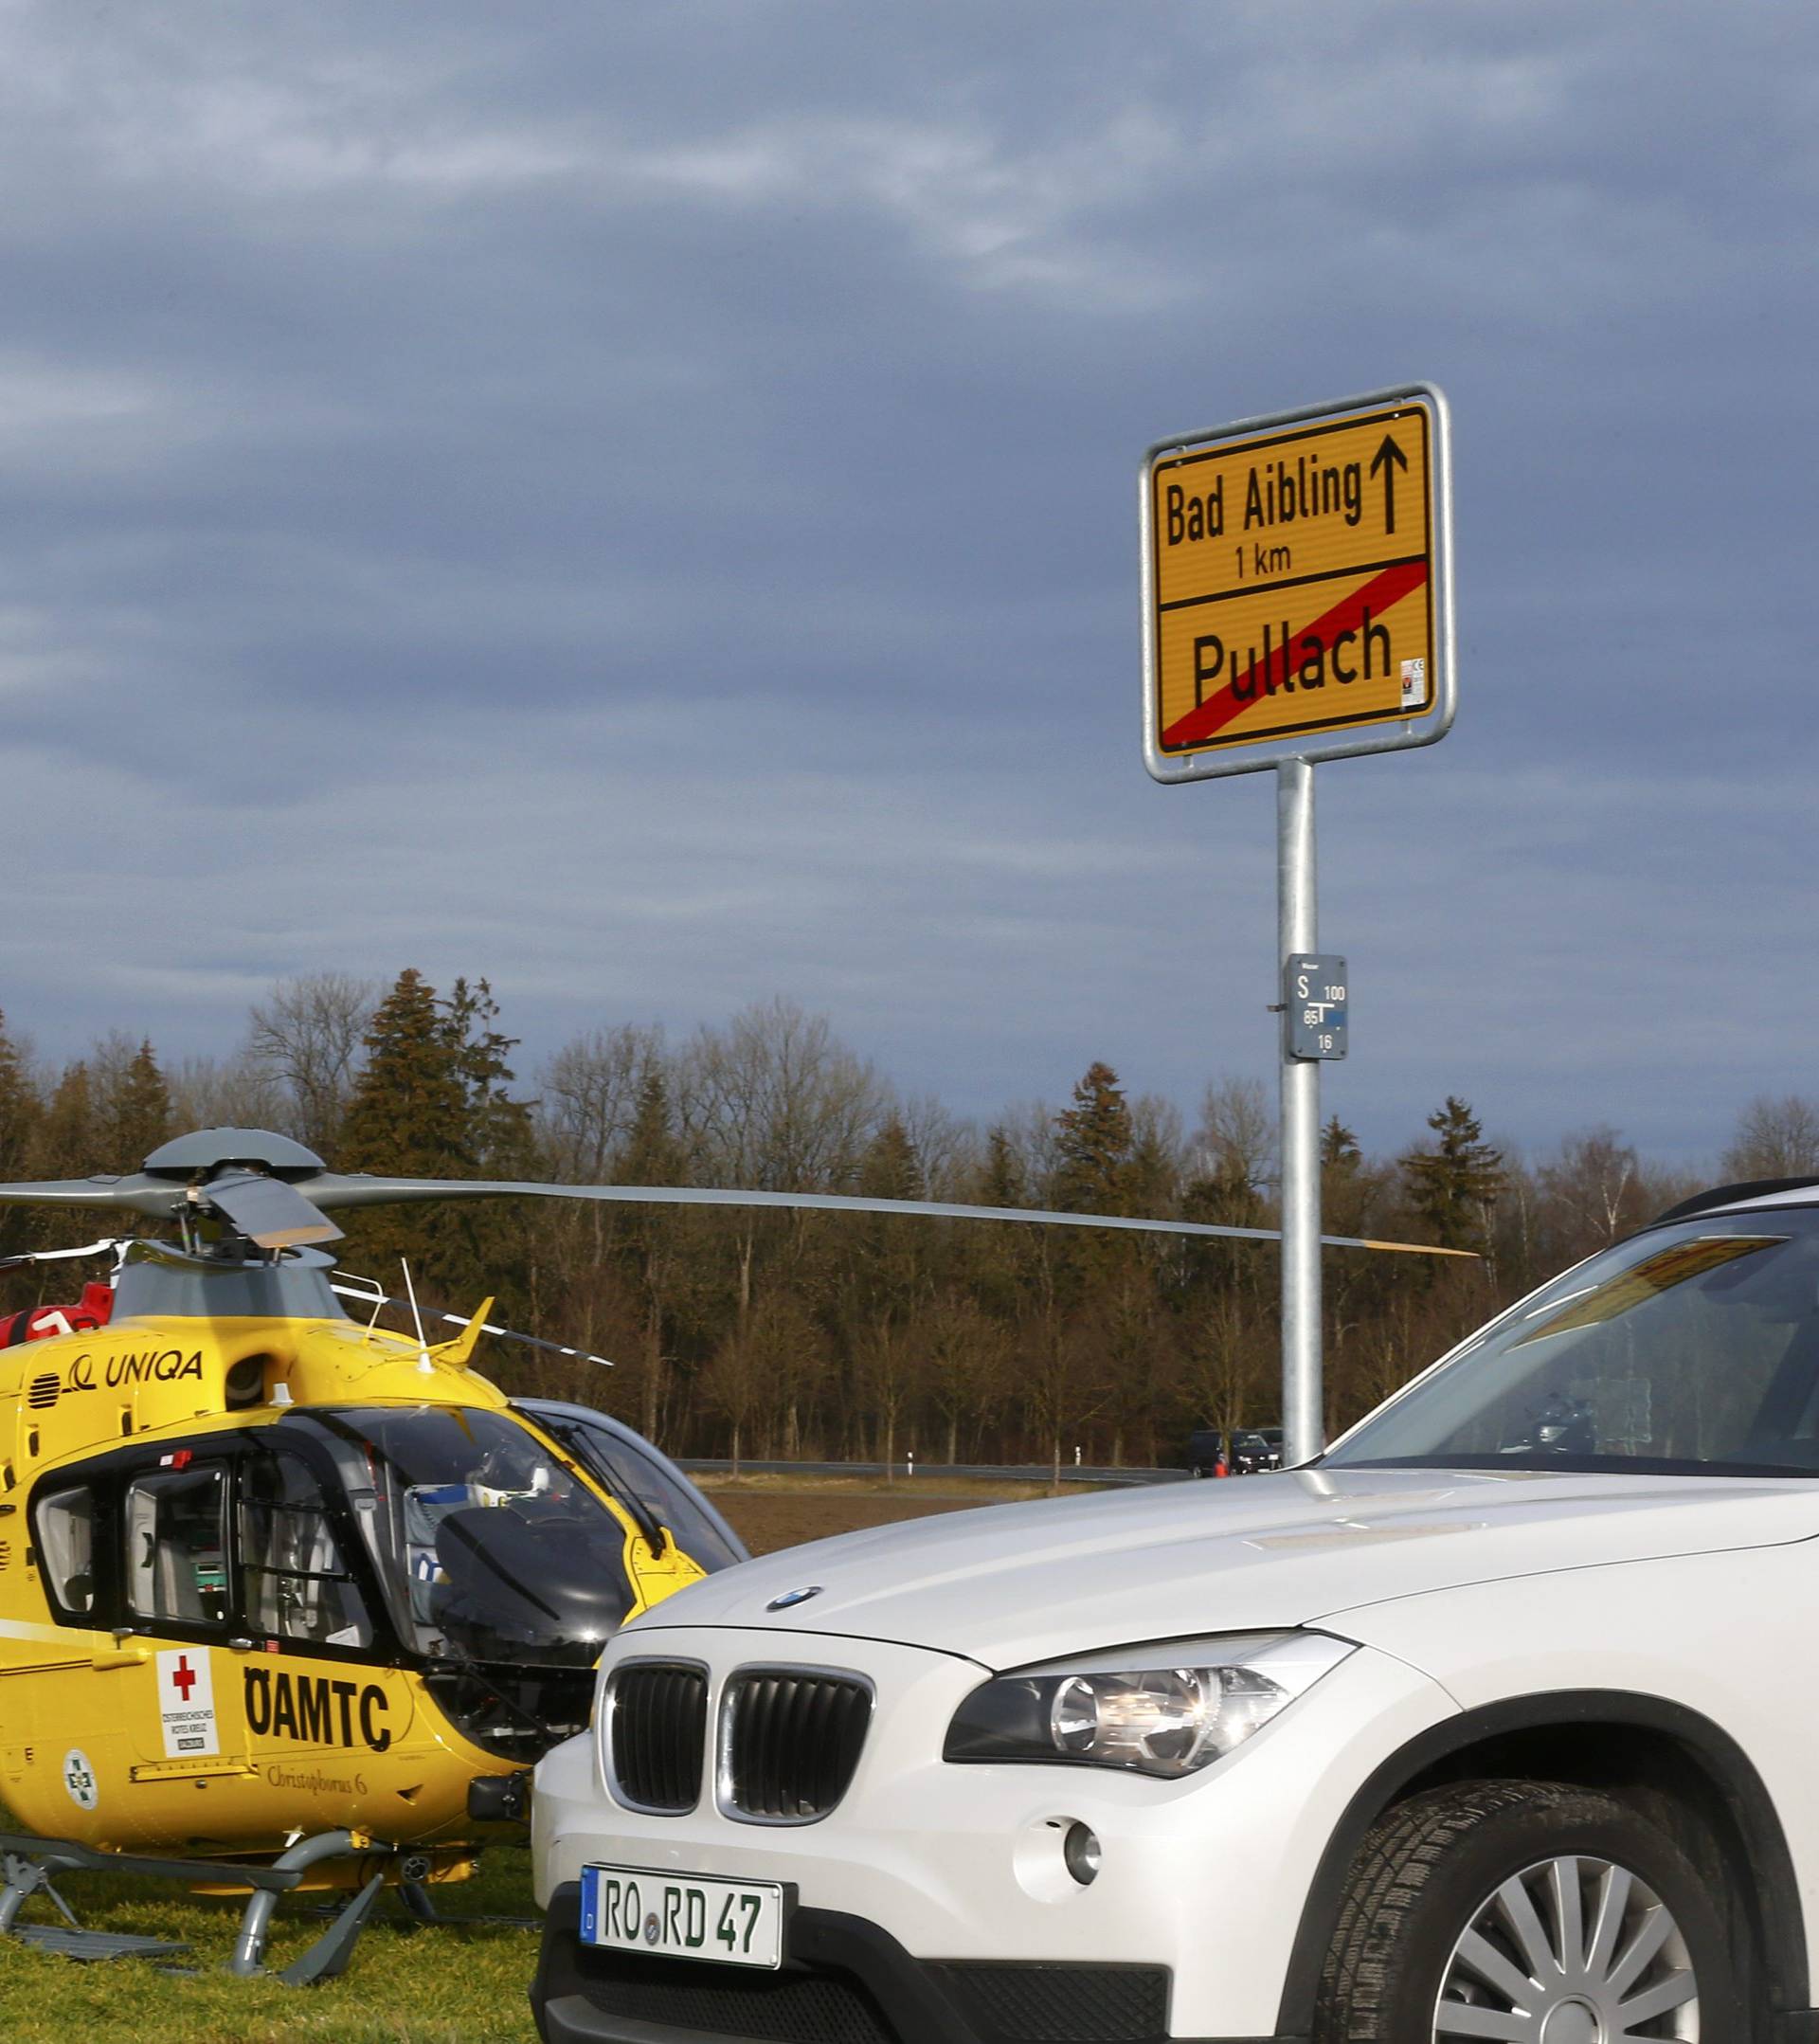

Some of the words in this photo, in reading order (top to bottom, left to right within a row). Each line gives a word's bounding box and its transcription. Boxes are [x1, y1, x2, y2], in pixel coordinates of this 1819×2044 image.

[1167, 474, 1224, 547] Bad
[1244, 454, 1362, 531] Aibling
[1235, 546, 1244, 579] 1
[1254, 542, 1291, 575] km
[1194, 606, 1392, 709] Pullach
[1297, 974, 1309, 999] S
[1324, 986, 1345, 1001] 100
[1318, 1034, 1333, 1049] 16
[105, 1349, 203, 1387] UNIQA
[243, 1666, 391, 1753] ÖAMTC
[354, 1773, 368, 1796] 6
[585, 1913, 593, 1929] D
[606, 1879, 641, 1941] RO
[663, 1887, 707, 1947] RD
[717, 1893, 762, 1953] 47
